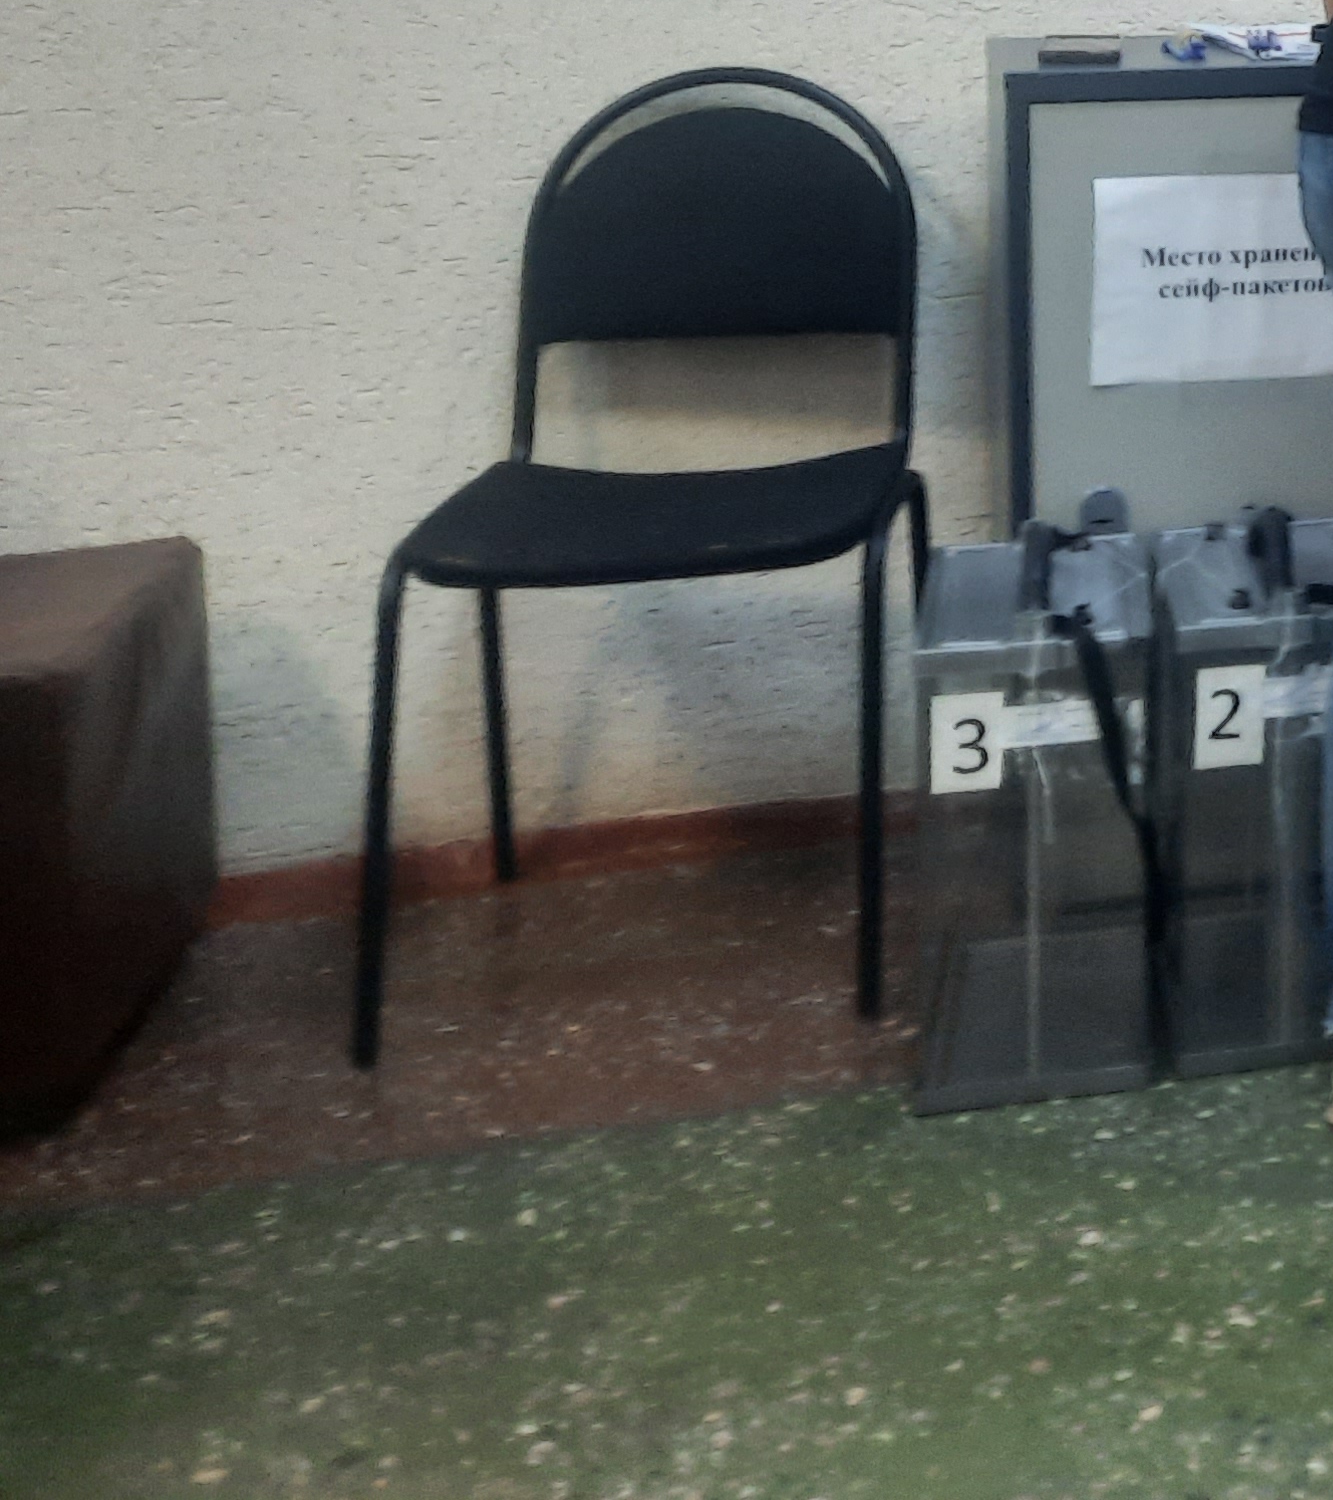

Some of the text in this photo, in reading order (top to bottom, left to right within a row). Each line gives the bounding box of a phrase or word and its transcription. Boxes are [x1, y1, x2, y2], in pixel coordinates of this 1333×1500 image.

[1142, 246, 1317, 269] Место хранен
[1159, 277, 1332, 302] сейф-пакетов
[1208, 689, 1241, 740] 2
[953, 718, 989, 775] 3
